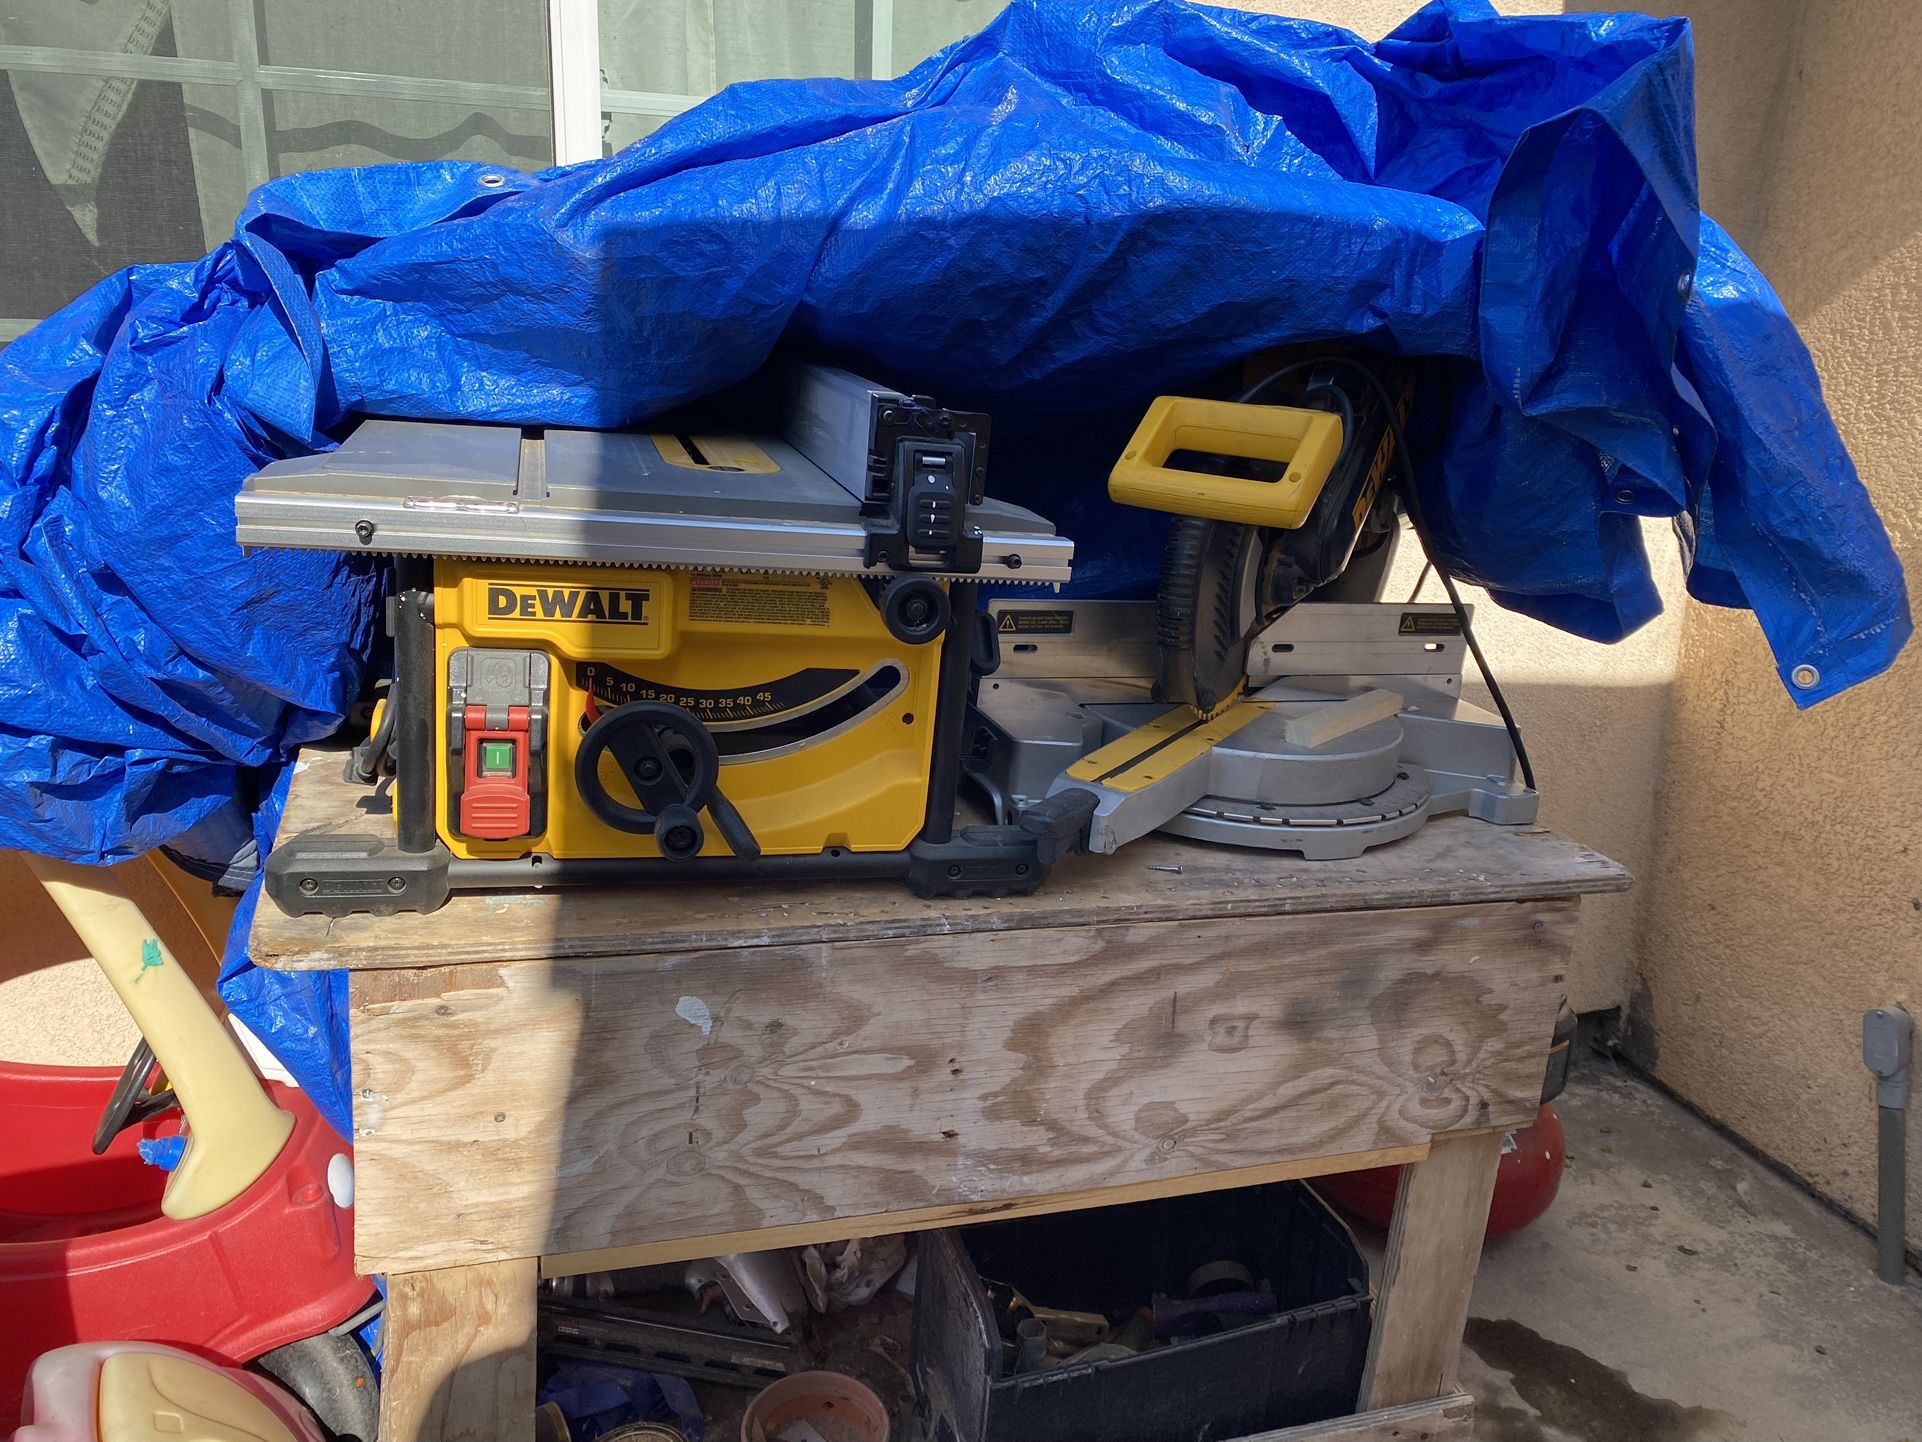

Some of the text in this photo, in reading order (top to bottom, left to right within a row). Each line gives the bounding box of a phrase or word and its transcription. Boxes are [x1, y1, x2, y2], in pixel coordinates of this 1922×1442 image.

[587, 666, 772, 708] 0 5 10 15 20 25 30 35 40 45
